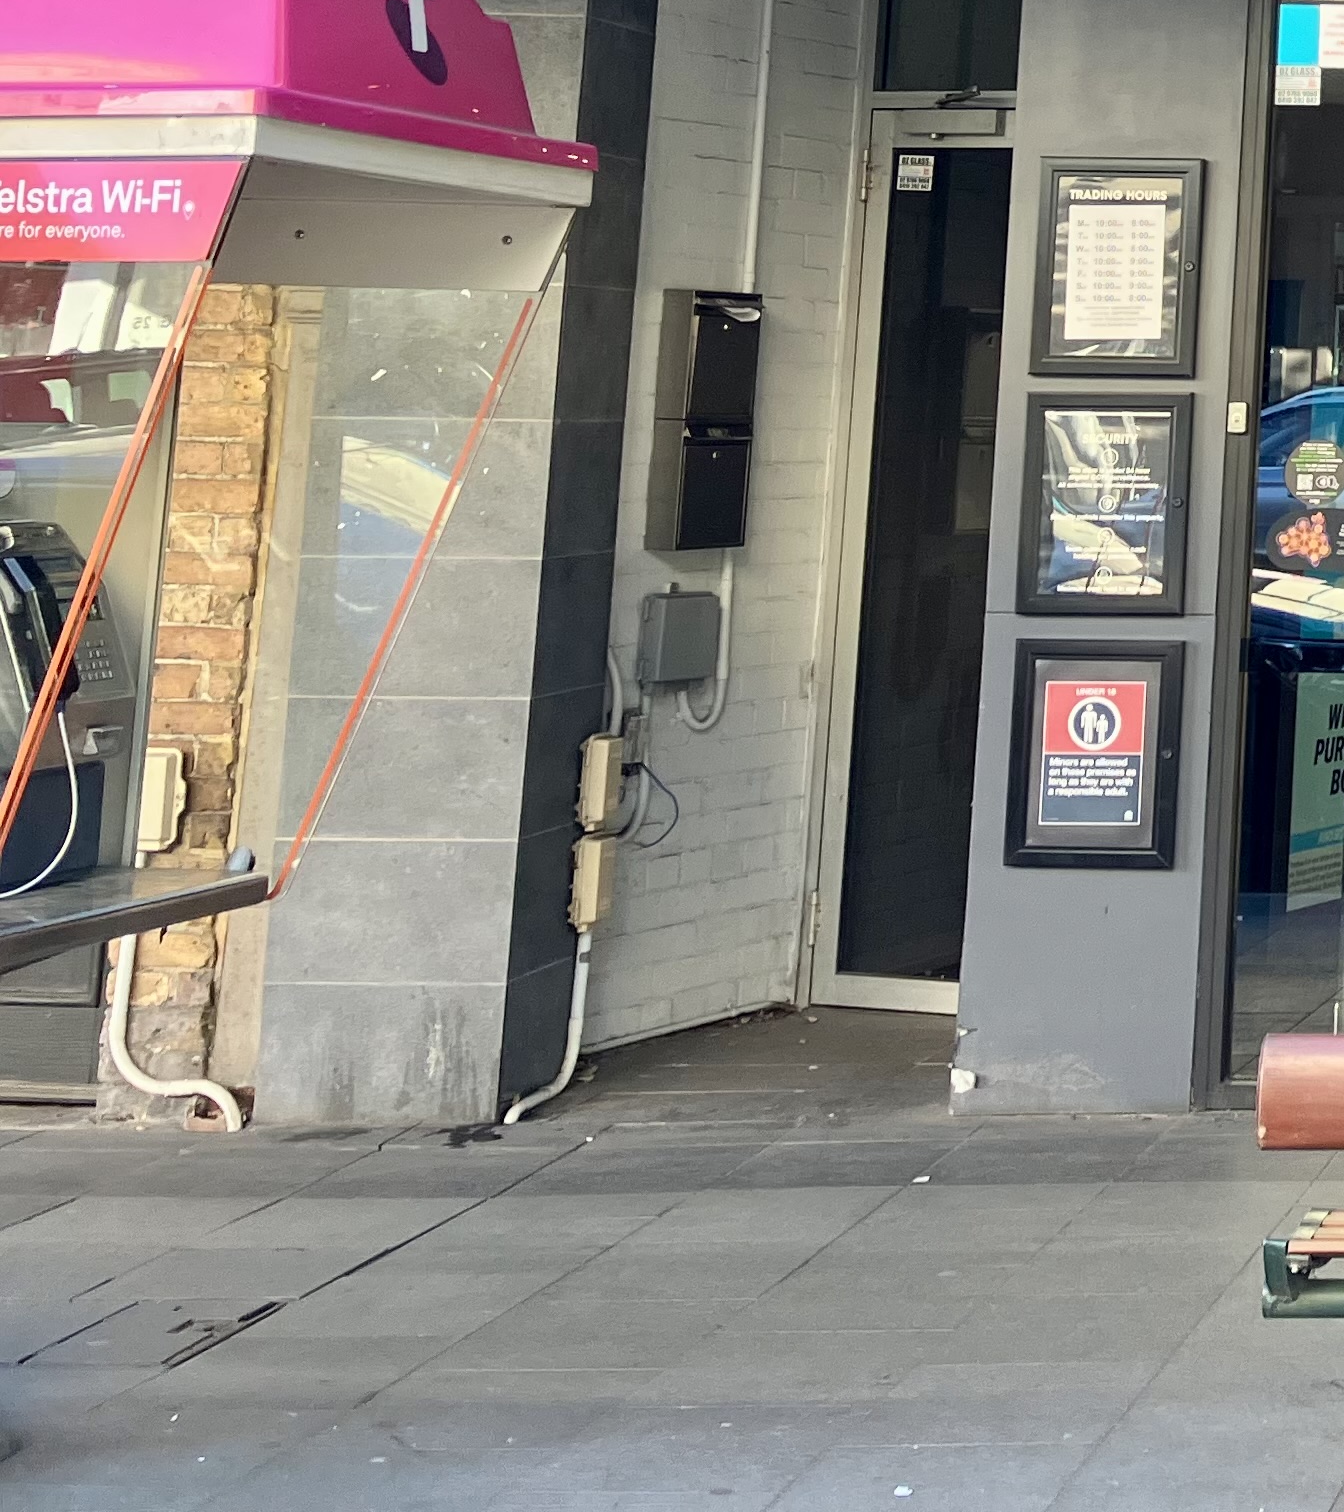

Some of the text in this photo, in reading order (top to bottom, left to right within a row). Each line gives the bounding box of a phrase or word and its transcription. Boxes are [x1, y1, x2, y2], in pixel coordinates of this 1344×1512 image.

[0, 179, 92, 214] elstra
[1069, 189, 1167, 201] TRADING HOURS
[19, 222, 125, 243] for everyone.
[1076, 688, 1105, 696] UNDER
